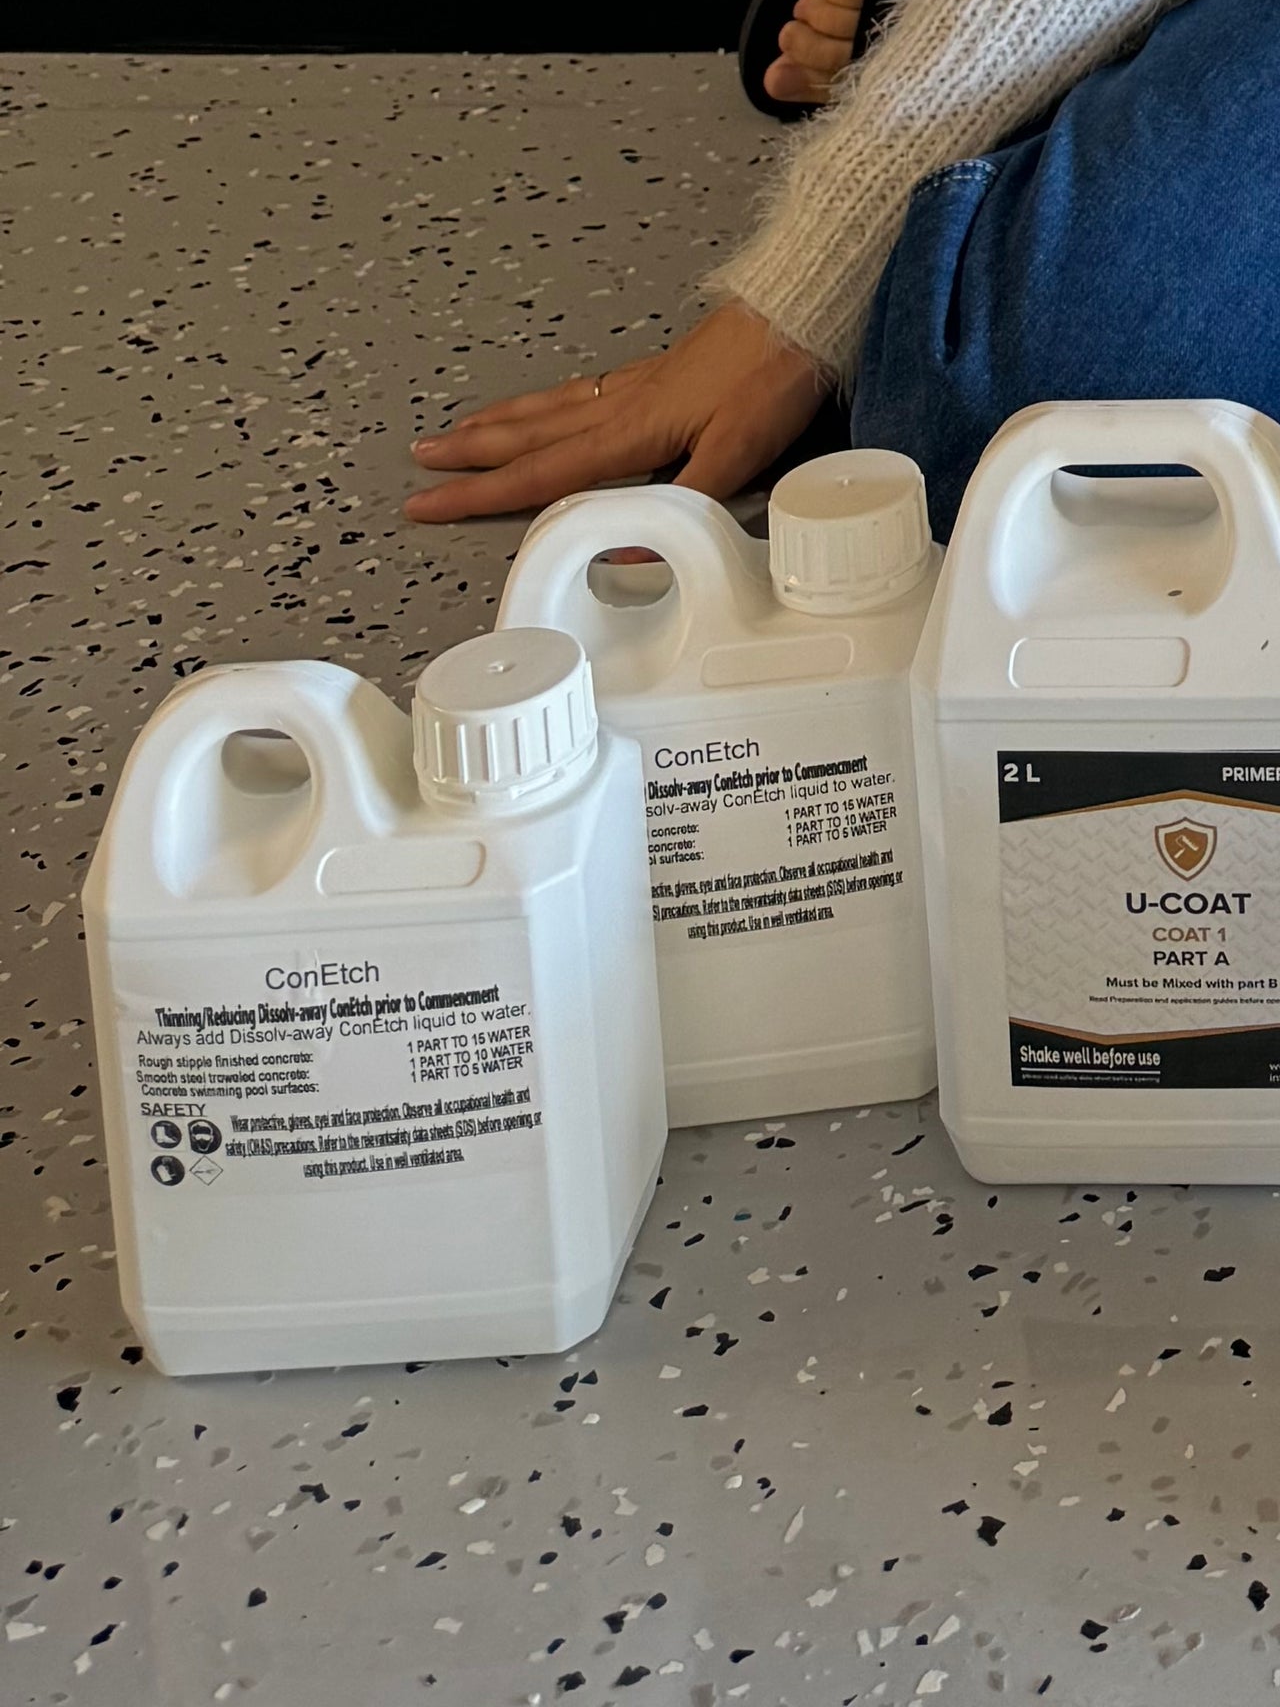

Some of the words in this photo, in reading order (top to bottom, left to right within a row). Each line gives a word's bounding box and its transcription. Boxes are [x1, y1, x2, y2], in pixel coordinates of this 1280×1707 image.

[655, 738, 760, 768] ConEtch
[713, 768, 754, 792] ConEtch
[755, 765, 780, 790] prior
[782, 766, 793, 782] to
[1003, 762, 1020, 782] 2
[1027, 763, 1041, 782] L
[646, 798, 718, 818] solv-away
[723, 787, 786, 808] ConEtch
[790, 781, 829, 800] liquid
[833, 780, 847, 792] to
[850, 772, 896, 789] water.
[785, 809, 790, 820] 1
[793, 803, 823, 820] PART
[824, 802, 840, 815] TO
[842, 799, 855, 812] 15
[856, 792, 895, 810] WATER
[787, 824, 792, 834] 1
[795, 819, 824, 834] PART
[826, 816, 841, 829] TO
[844, 814, 857, 827] 10
[858, 806, 898, 824] WATER
[787, 836, 793, 847] 1
[796, 831, 823, 846] PART
[825, 829, 840, 841] TO
[842, 827, 849, 839] 5
[851, 820, 888, 837] WATER
[1125, 892, 1252, 915] U-COAT
[1152, 927, 1211, 942] COAT
[1217, 927, 1227, 942] 1
[1153, 951, 1208, 966] PART
[1214, 951, 1230, 966] A
[265, 961, 380, 990] ConEtch
[1106, 977, 1139, 988] Must
[1142, 977, 1159, 988] be
[1162, 978, 1202, 989] Mixed
[1205, 978, 1234, 989] with
[1238, 979, 1265, 991] part
[1268, 978, 1278, 988] B
[329, 994, 373, 1019] ConEtch
[375, 993, 402, 1020] prior
[403, 993, 416, 1012] to
[137, 1030, 191, 1049] Always
[195, 1030, 225, 1045] add
[230, 1026, 334, 1044] Dissolv-away
[340, 1016, 408, 1037] ConEtch
[413, 1011, 456, 1032] liquid
[461, 1011, 477, 1025] to
[481, 1003, 531, 1022] water.
[138, 1055, 173, 1070] Rough
[215, 1053, 259, 1067] finished
[407, 1041, 413, 1053] 1
[417, 1037, 449, 1053] PART
[451, 1035, 468, 1049] TO
[472, 1032, 486, 1046] 15
[487, 1025, 531, 1044] WATER
[1019, 1044, 1061, 1063] Shake
[1062, 1046, 1091, 1065] well
[1093, 1047, 1136, 1069] before
[1137, 1052, 1161, 1066] use
[136, 1070, 178, 1084] Smooth
[410, 1058, 416, 1070] 1
[420, 1053, 452, 1068] PART
[454, 1050, 471, 1064] TO
[474, 1048, 488, 1062] 10
[490, 1041, 534, 1059] WATER
[142, 1084, 188, 1097] Concrete
[190, 1085, 242, 1099] swimming
[246, 1084, 268, 1098] pool
[411, 1071, 417, 1083] 1
[420, 1067, 450, 1082] PART
[453, 1064, 470, 1077] TO
[472, 1063, 480, 1075] 5
[481, 1056, 524, 1074] WATER
[140, 1103, 207, 1117] SAFETY
